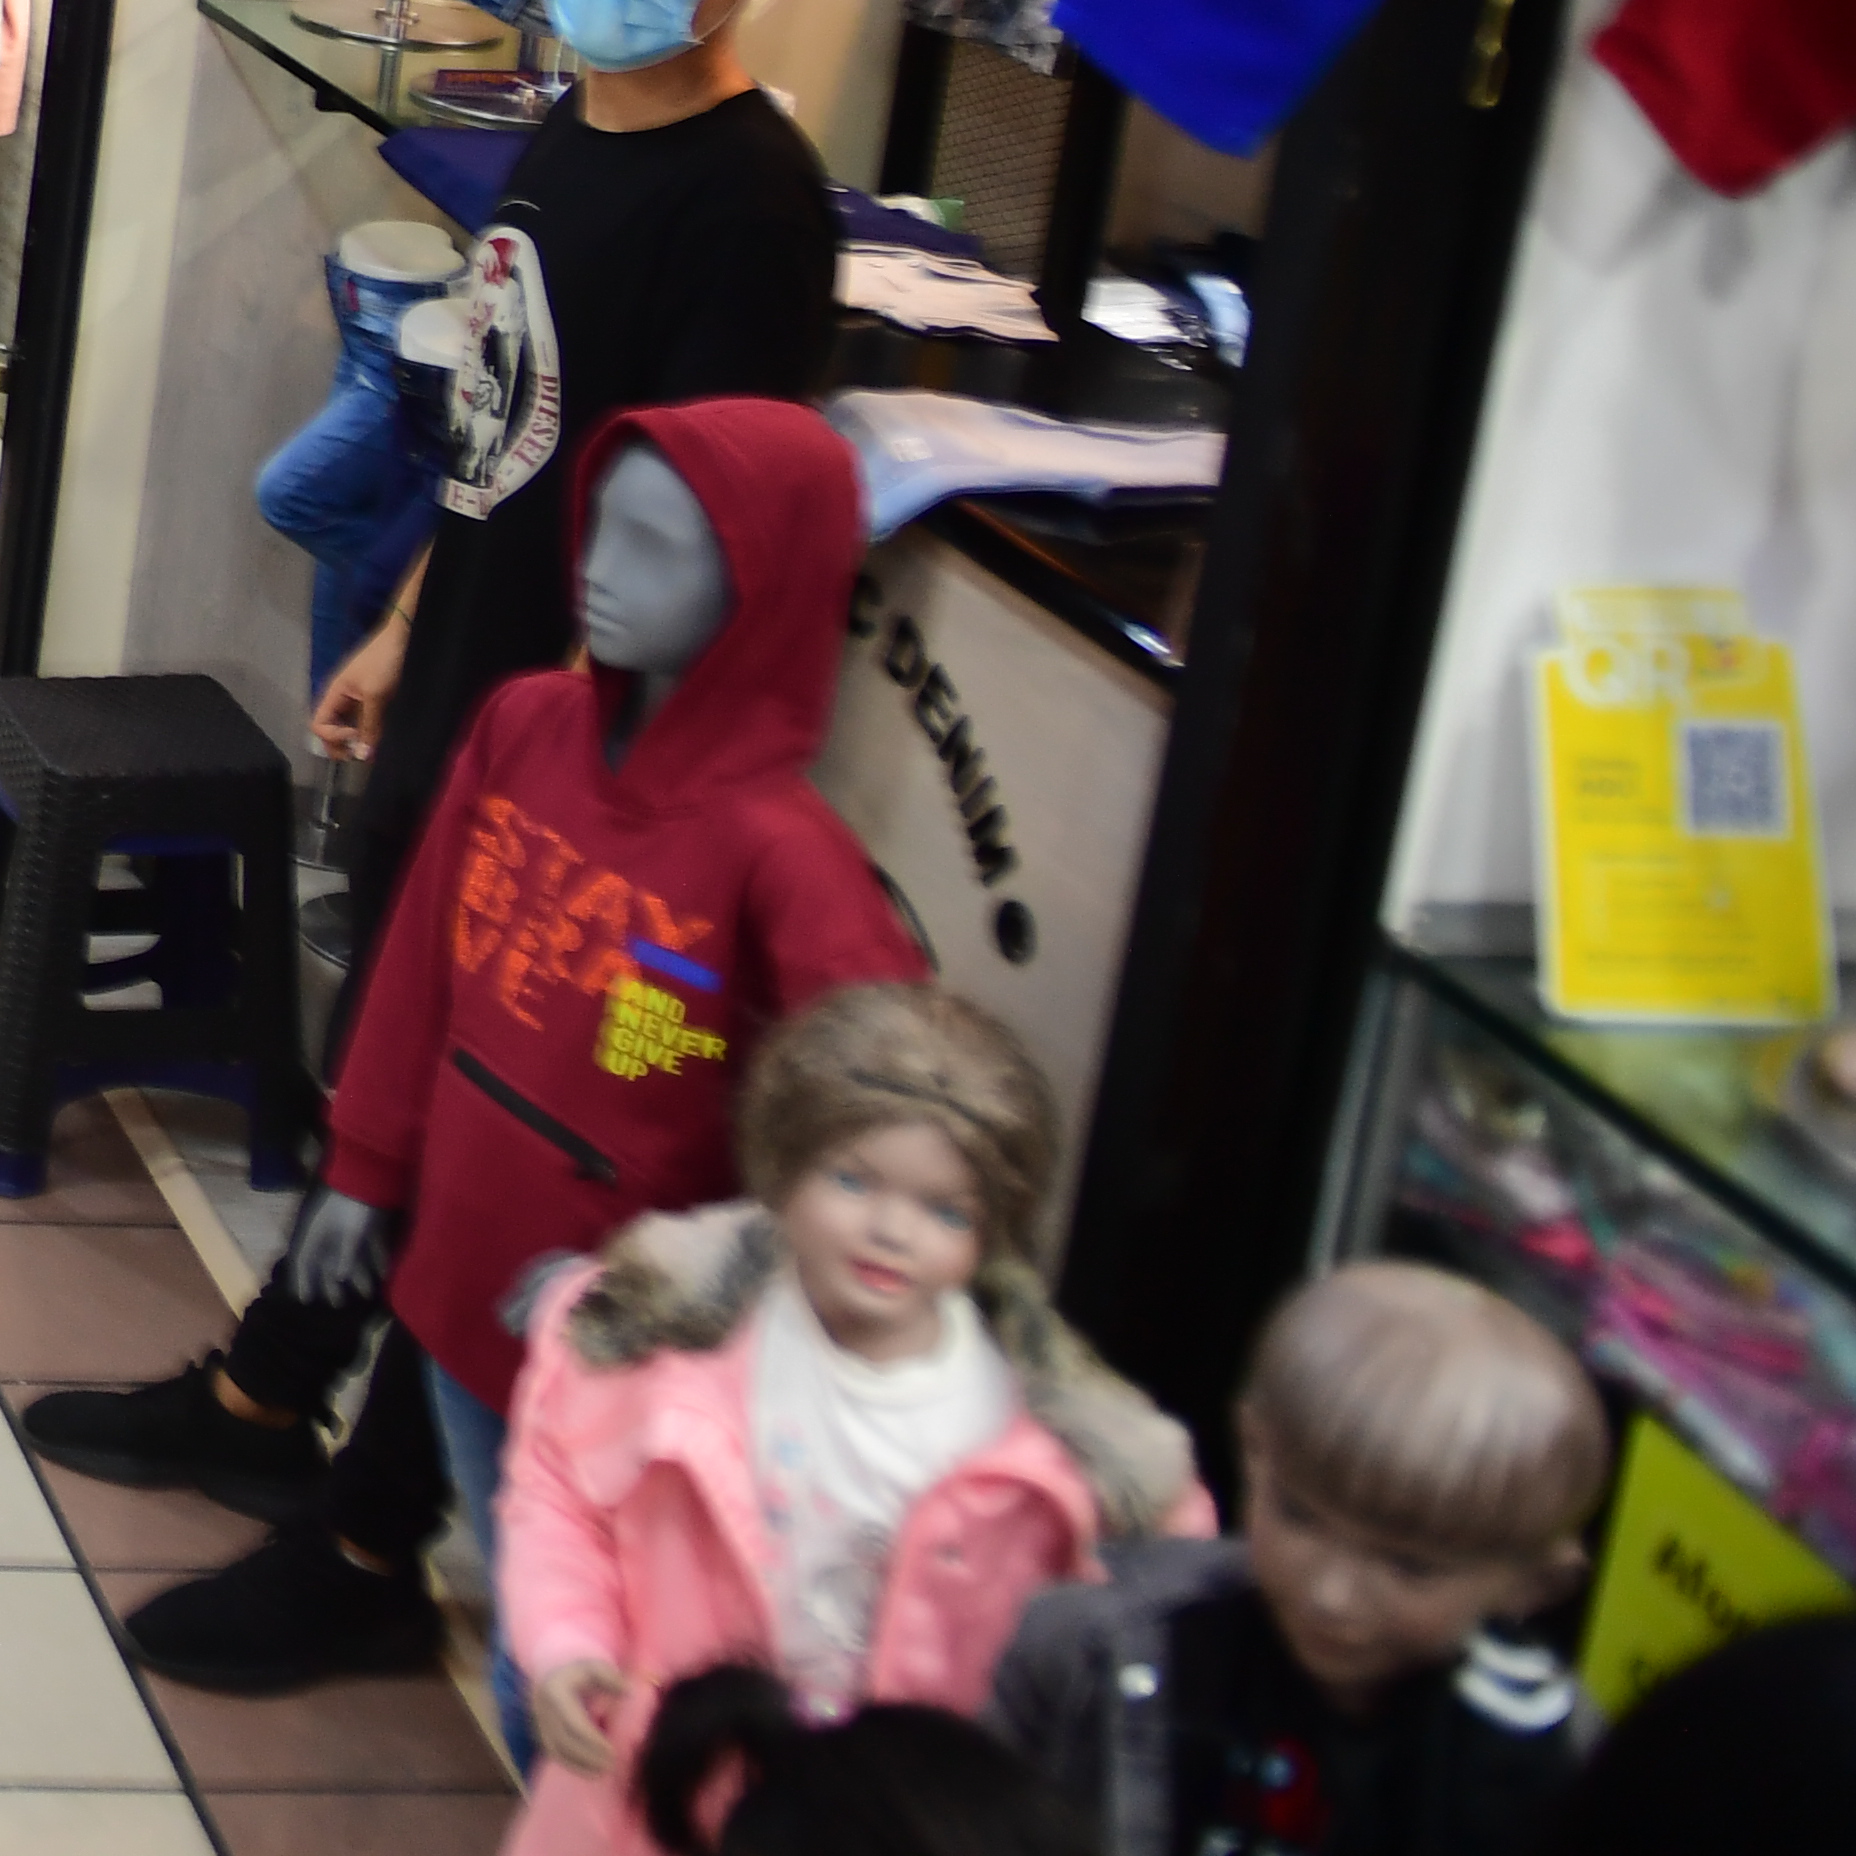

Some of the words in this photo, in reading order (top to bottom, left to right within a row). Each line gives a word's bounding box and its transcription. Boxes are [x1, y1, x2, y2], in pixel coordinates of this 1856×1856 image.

[885, 614, 1019, 890] DENIM
[472, 796, 715, 952] STAY
[610, 998, 729, 1062] NEVER
[614, 977, 687, 1025] AND
[600, 1048, 650, 1082] UP
[606, 1024, 684, 1078] GIVE
